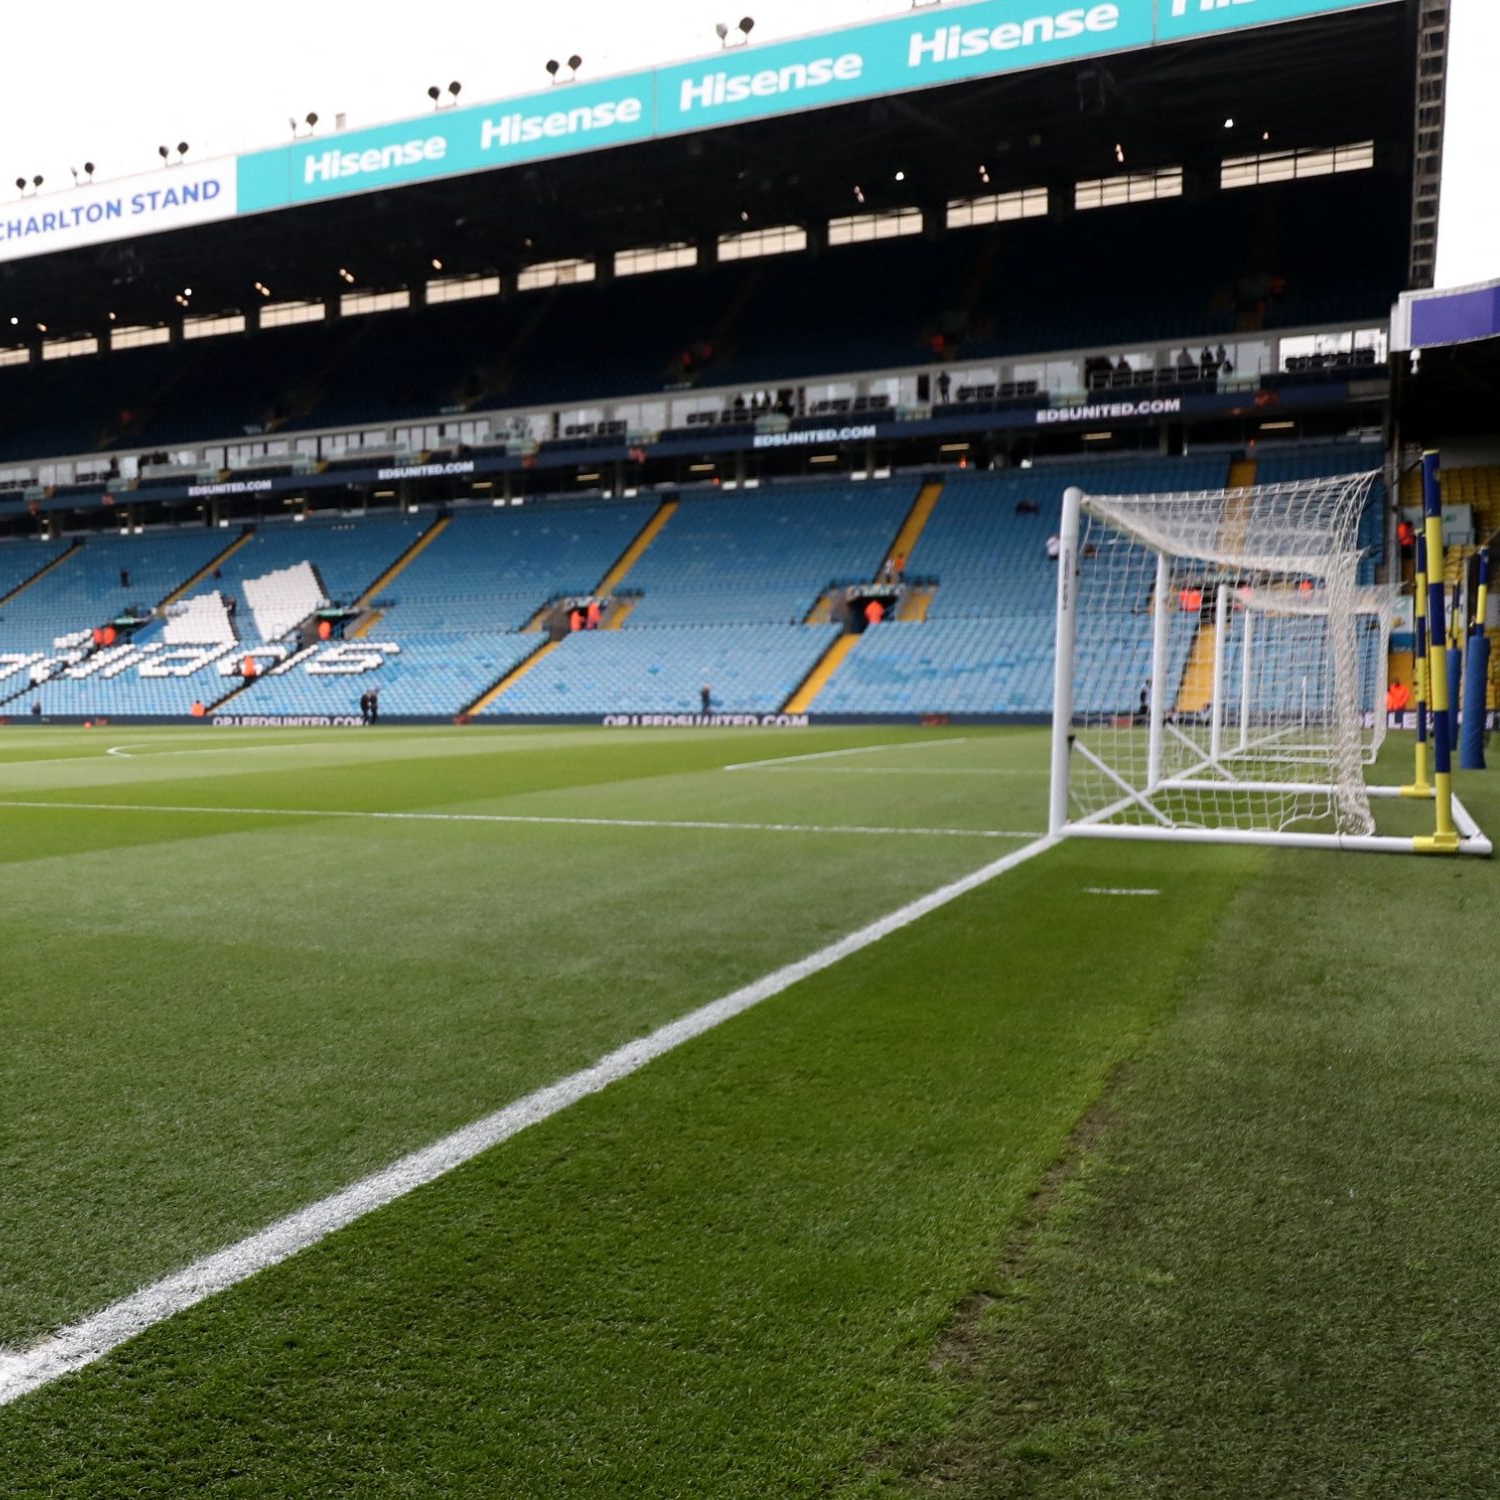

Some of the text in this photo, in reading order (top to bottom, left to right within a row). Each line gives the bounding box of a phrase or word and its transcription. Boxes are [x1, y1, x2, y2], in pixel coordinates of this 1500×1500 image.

[907, 3, 1120, 67] Hisense
[680, 52, 863, 111] Hisense
[480, 97, 641, 149] Hisense
[304, 134, 447, 184] Hisense
[131, 179, 221, 215] STAND
[1036, 398, 1180, 424] EDSUNITED.COM
[753, 425, 876, 448] EDSUNITED.COM
[188, 480, 271, 497] EDSUNITED.COM
[378, 461, 474, 480] EDSUNITED.COM
